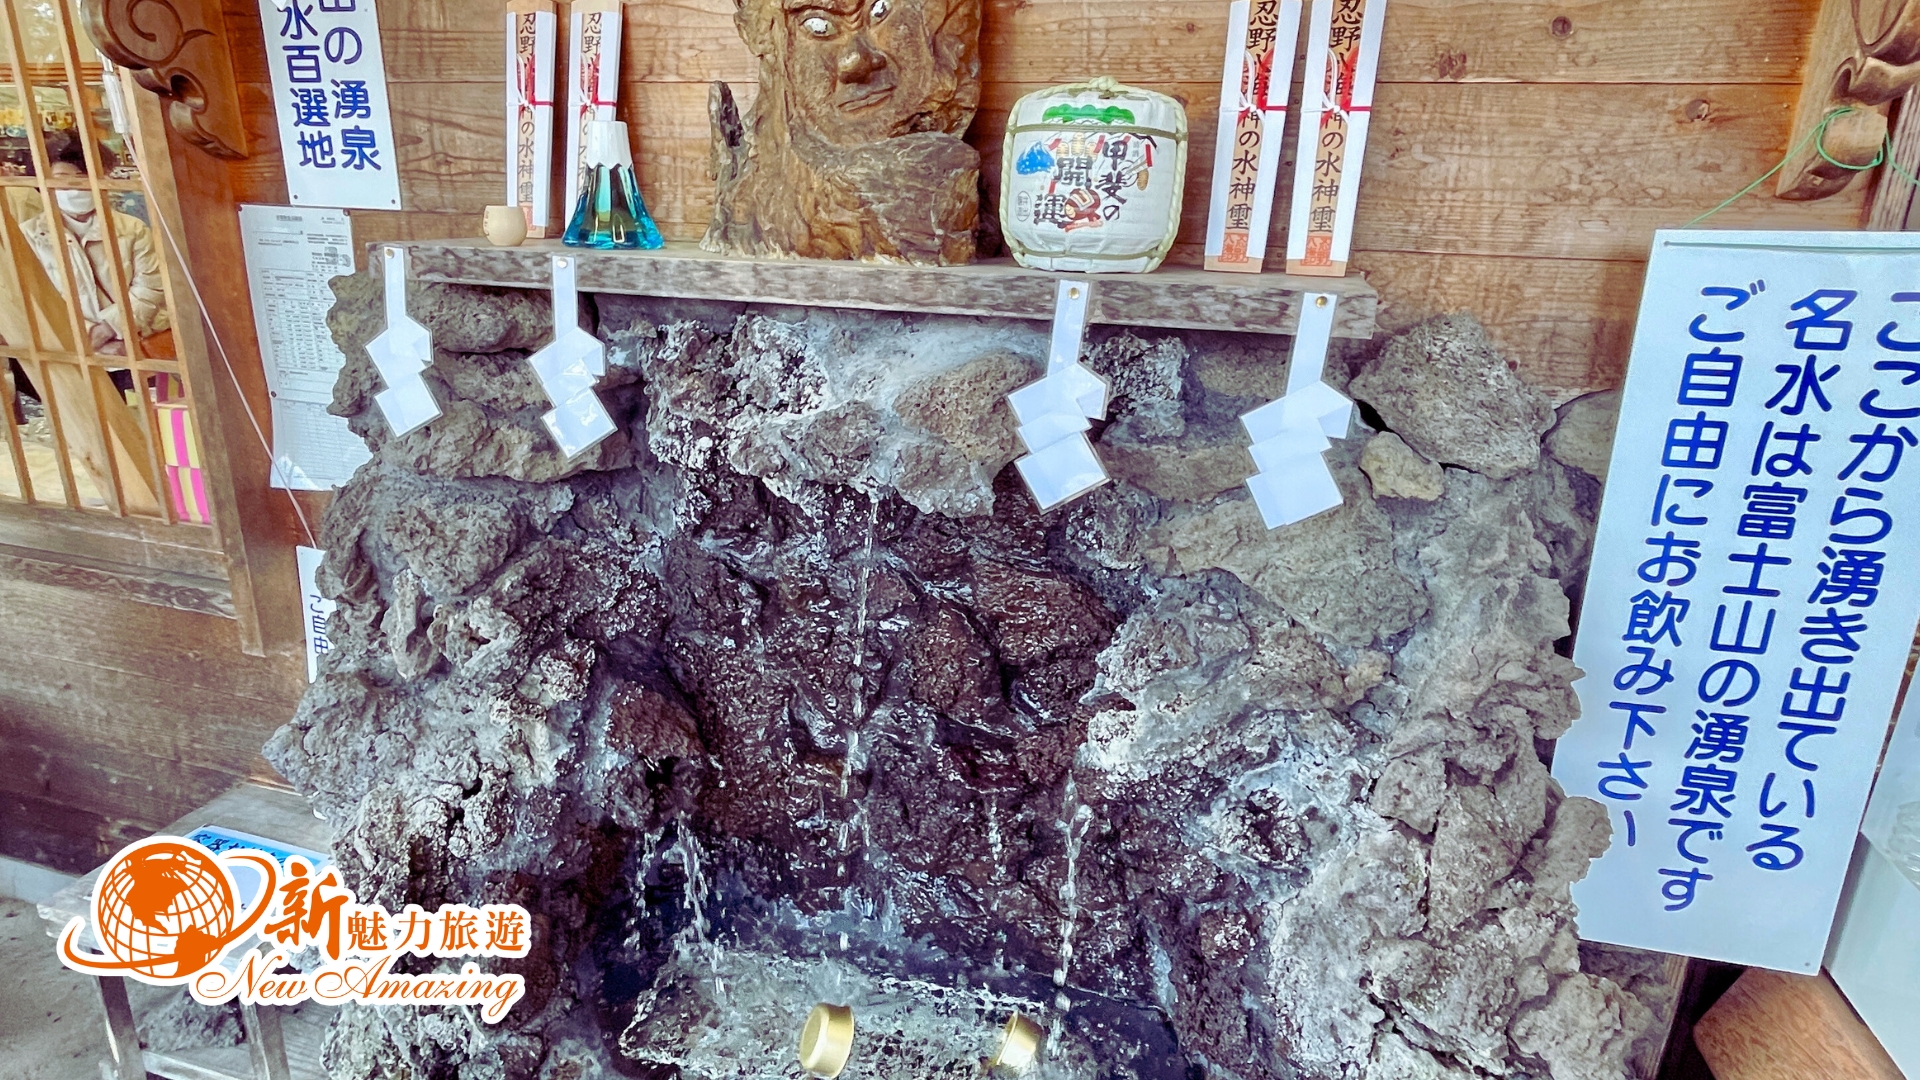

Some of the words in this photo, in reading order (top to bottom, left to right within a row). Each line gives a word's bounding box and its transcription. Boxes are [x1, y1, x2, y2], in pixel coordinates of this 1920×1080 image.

[1658, 289, 1858, 912] 名水は富士山の湧泉です
